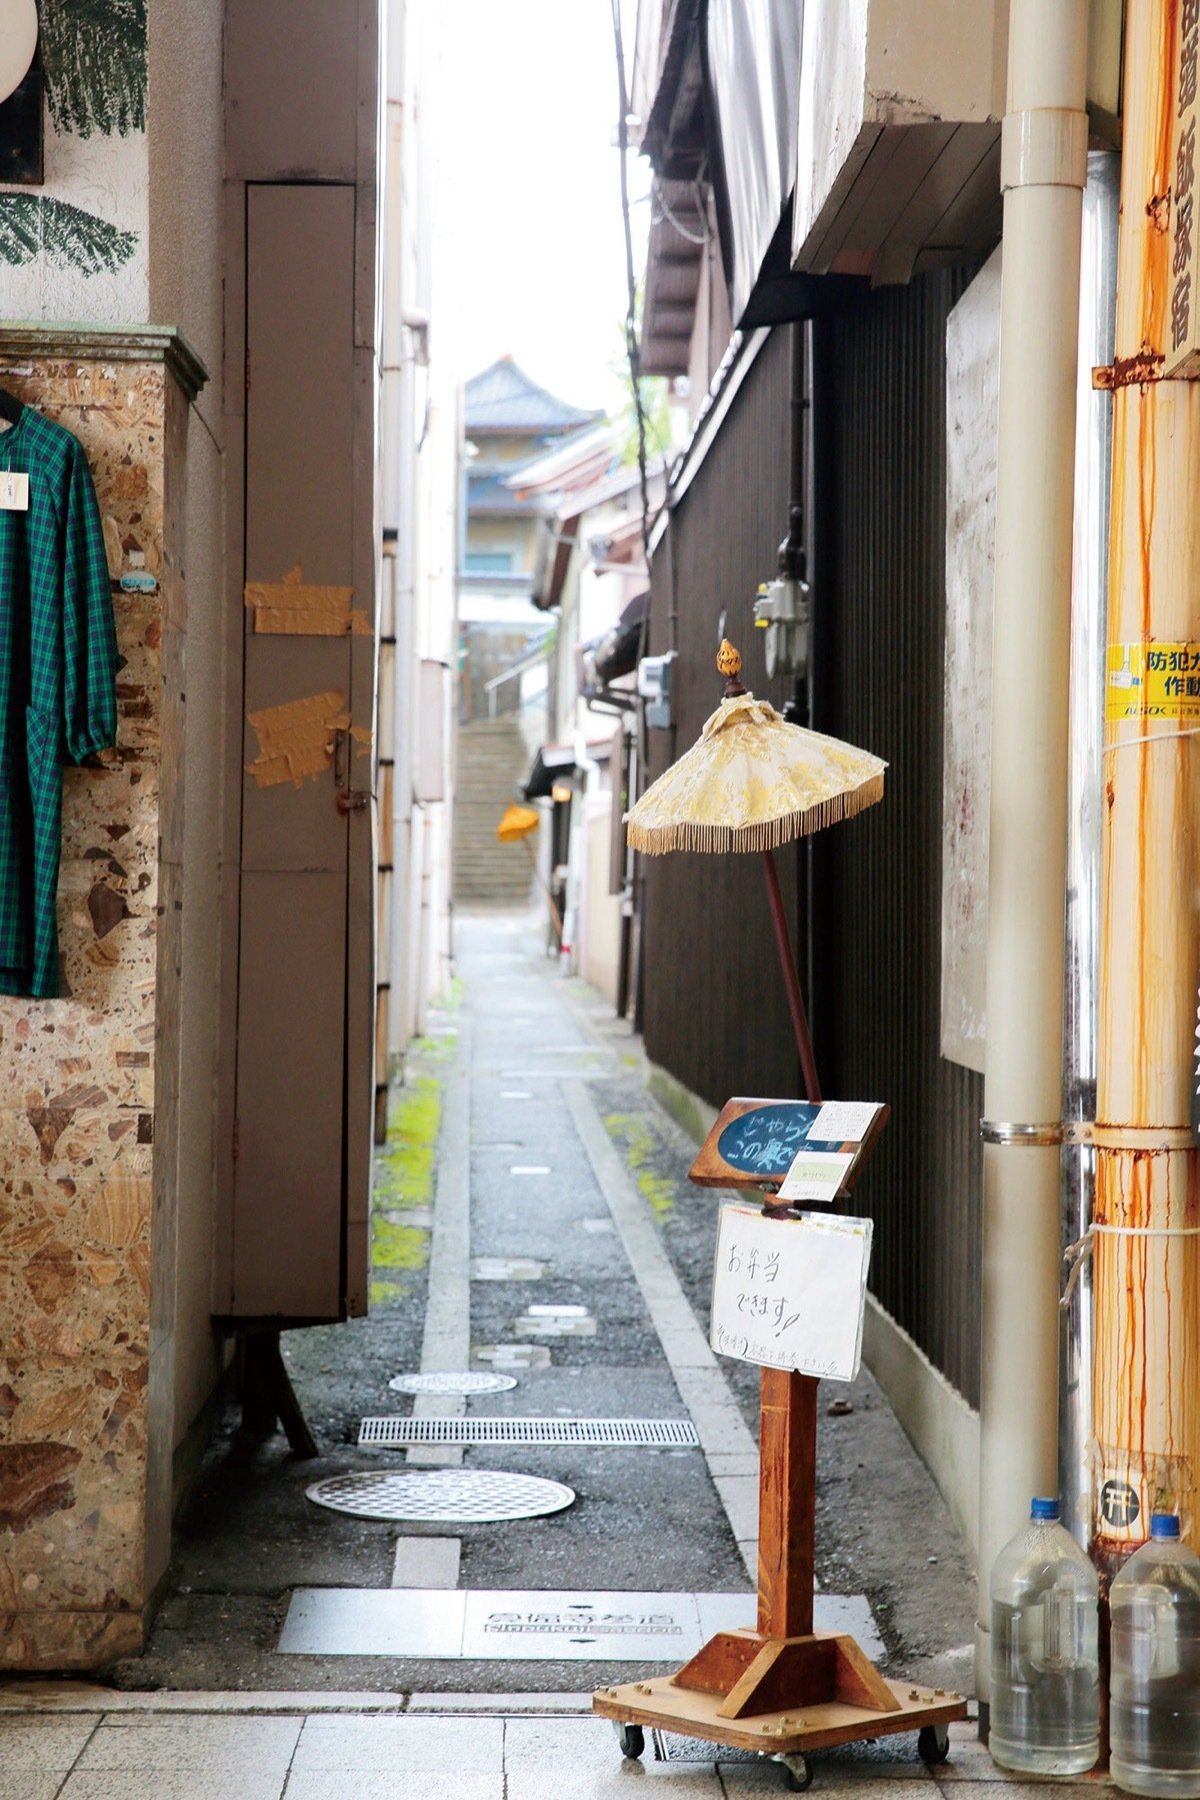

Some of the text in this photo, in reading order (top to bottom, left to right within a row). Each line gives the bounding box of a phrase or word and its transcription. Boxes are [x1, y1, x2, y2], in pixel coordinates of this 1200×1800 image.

[727, 1138, 813, 1171] この奥で
[728, 1245, 780, 1282] お弁当
